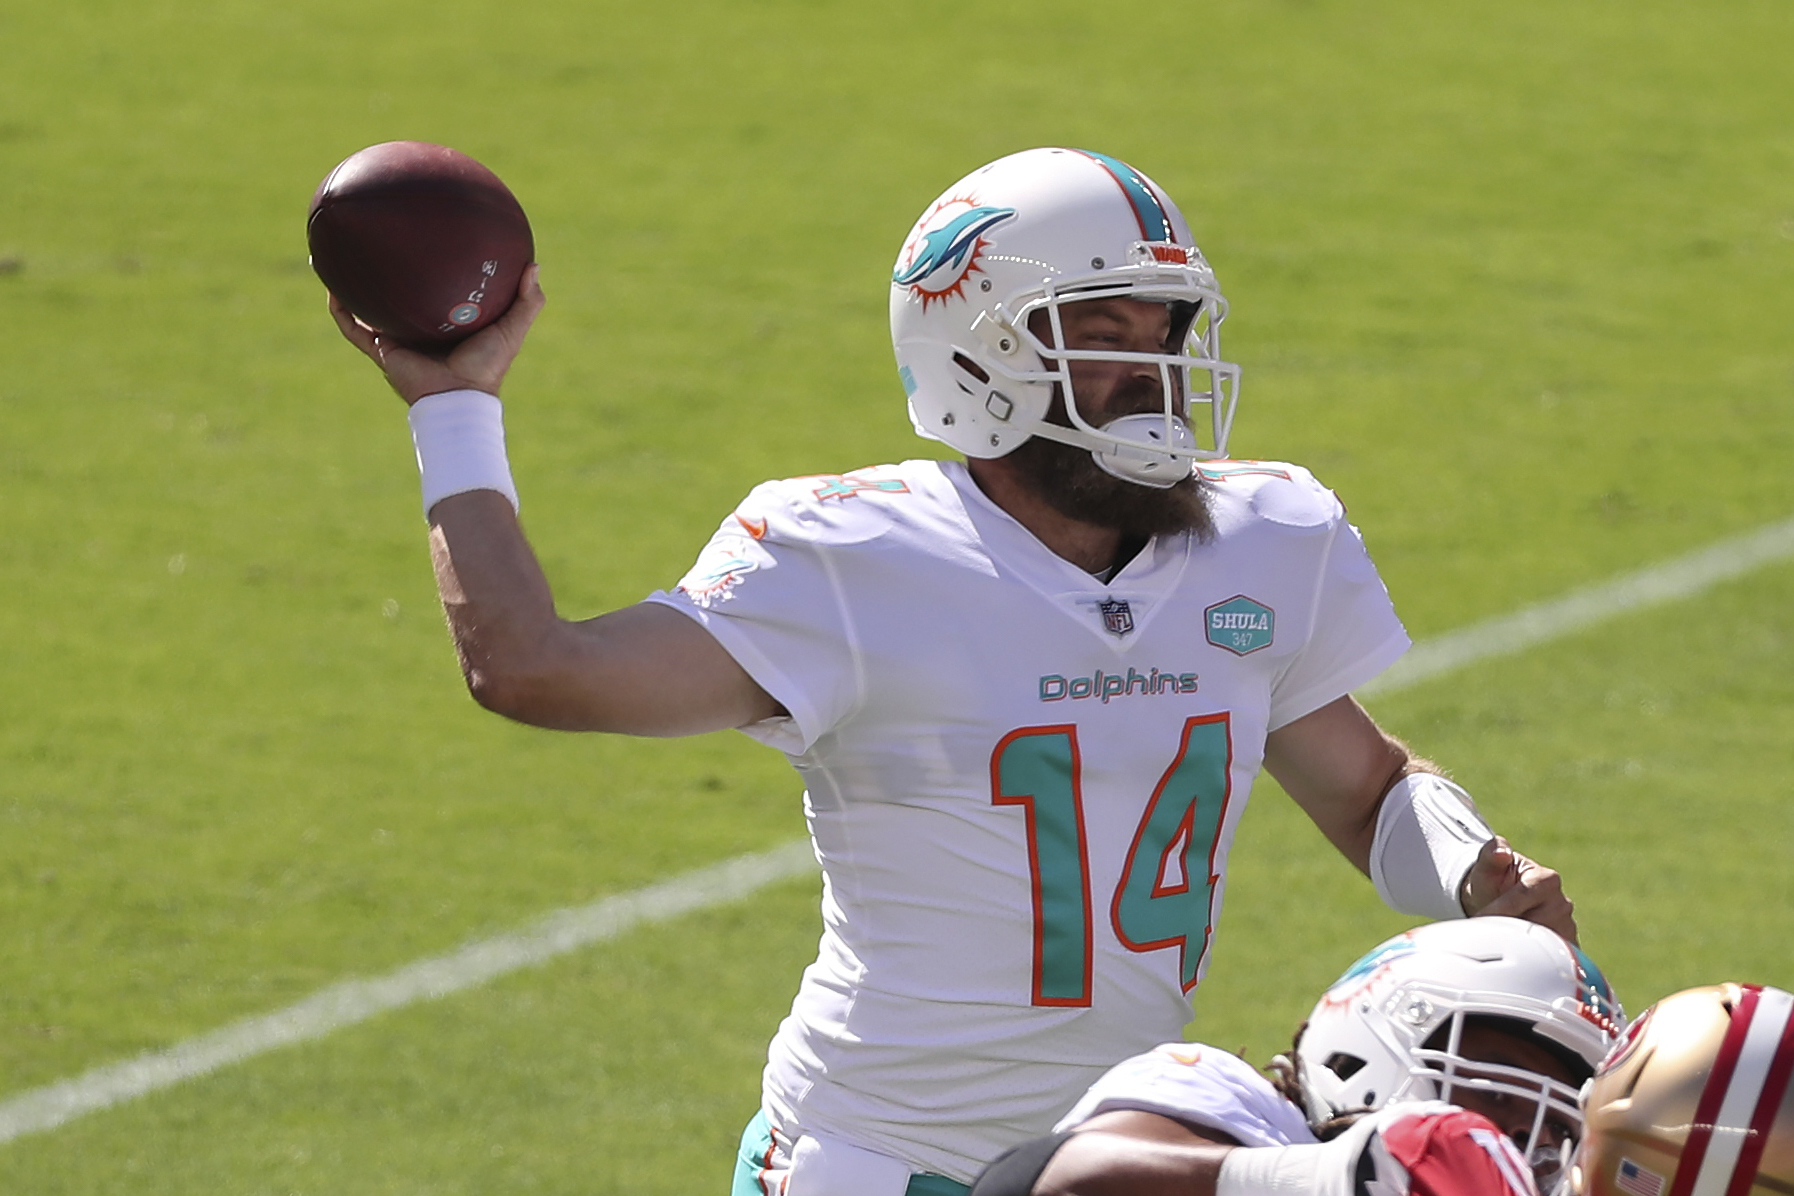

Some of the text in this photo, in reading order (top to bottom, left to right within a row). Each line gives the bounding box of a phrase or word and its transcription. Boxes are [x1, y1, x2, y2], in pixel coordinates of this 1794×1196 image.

[1105, 613, 1131, 631] NFL
[1212, 613, 1268, 630] SHULA
[1232, 632, 1253, 647] 347
[1039, 667, 1200, 705] Dolphins
[989, 710, 1233, 1008] 14
